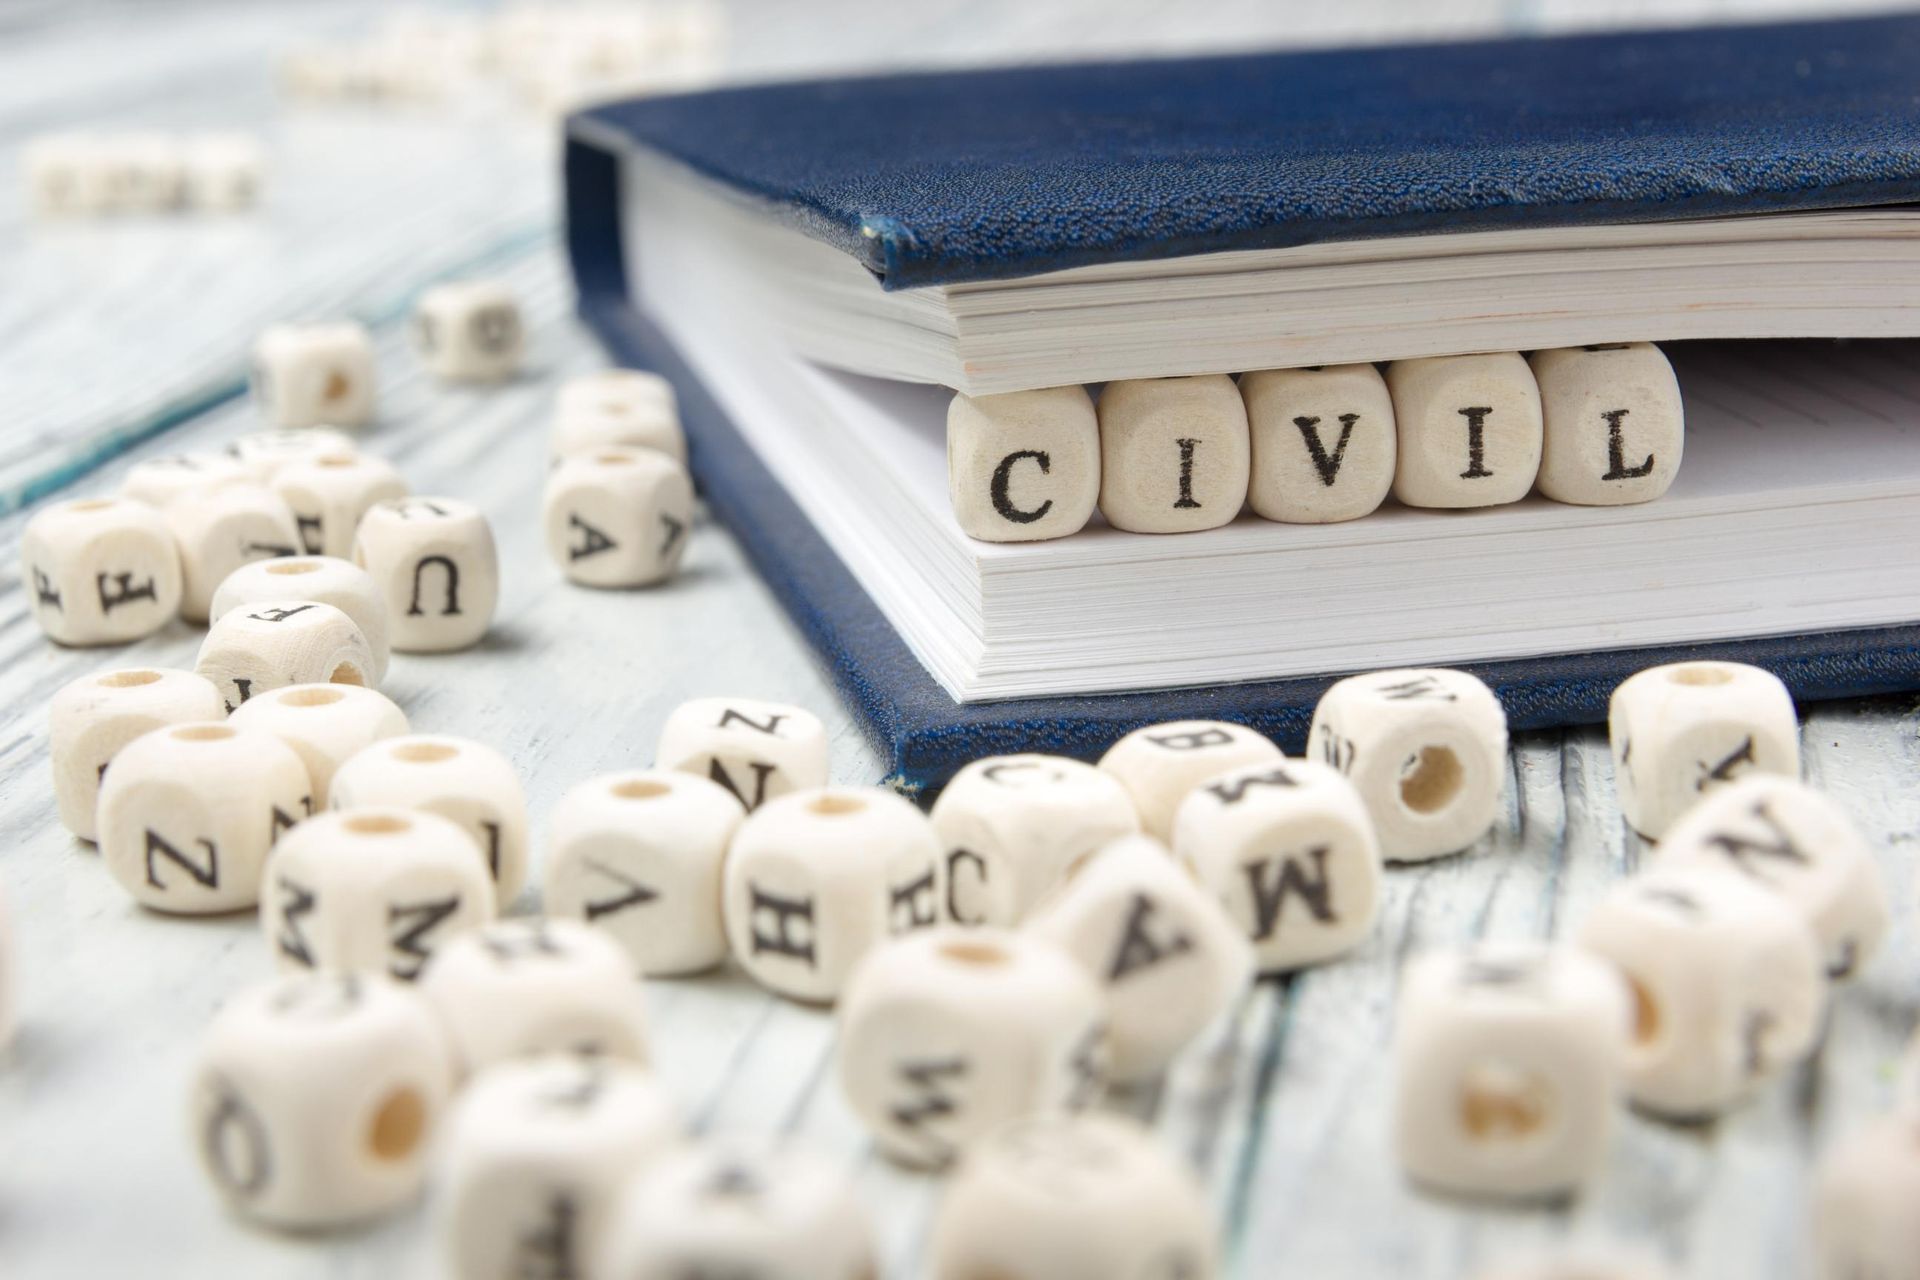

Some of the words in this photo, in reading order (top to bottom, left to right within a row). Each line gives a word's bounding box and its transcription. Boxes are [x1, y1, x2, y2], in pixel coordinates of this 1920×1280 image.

[990, 405, 1655, 525] CIVIL
[568, 511, 619, 561] A
[98, 572, 157, 615] F
[746, 874, 818, 970] H
[947, 847, 988, 926] C
